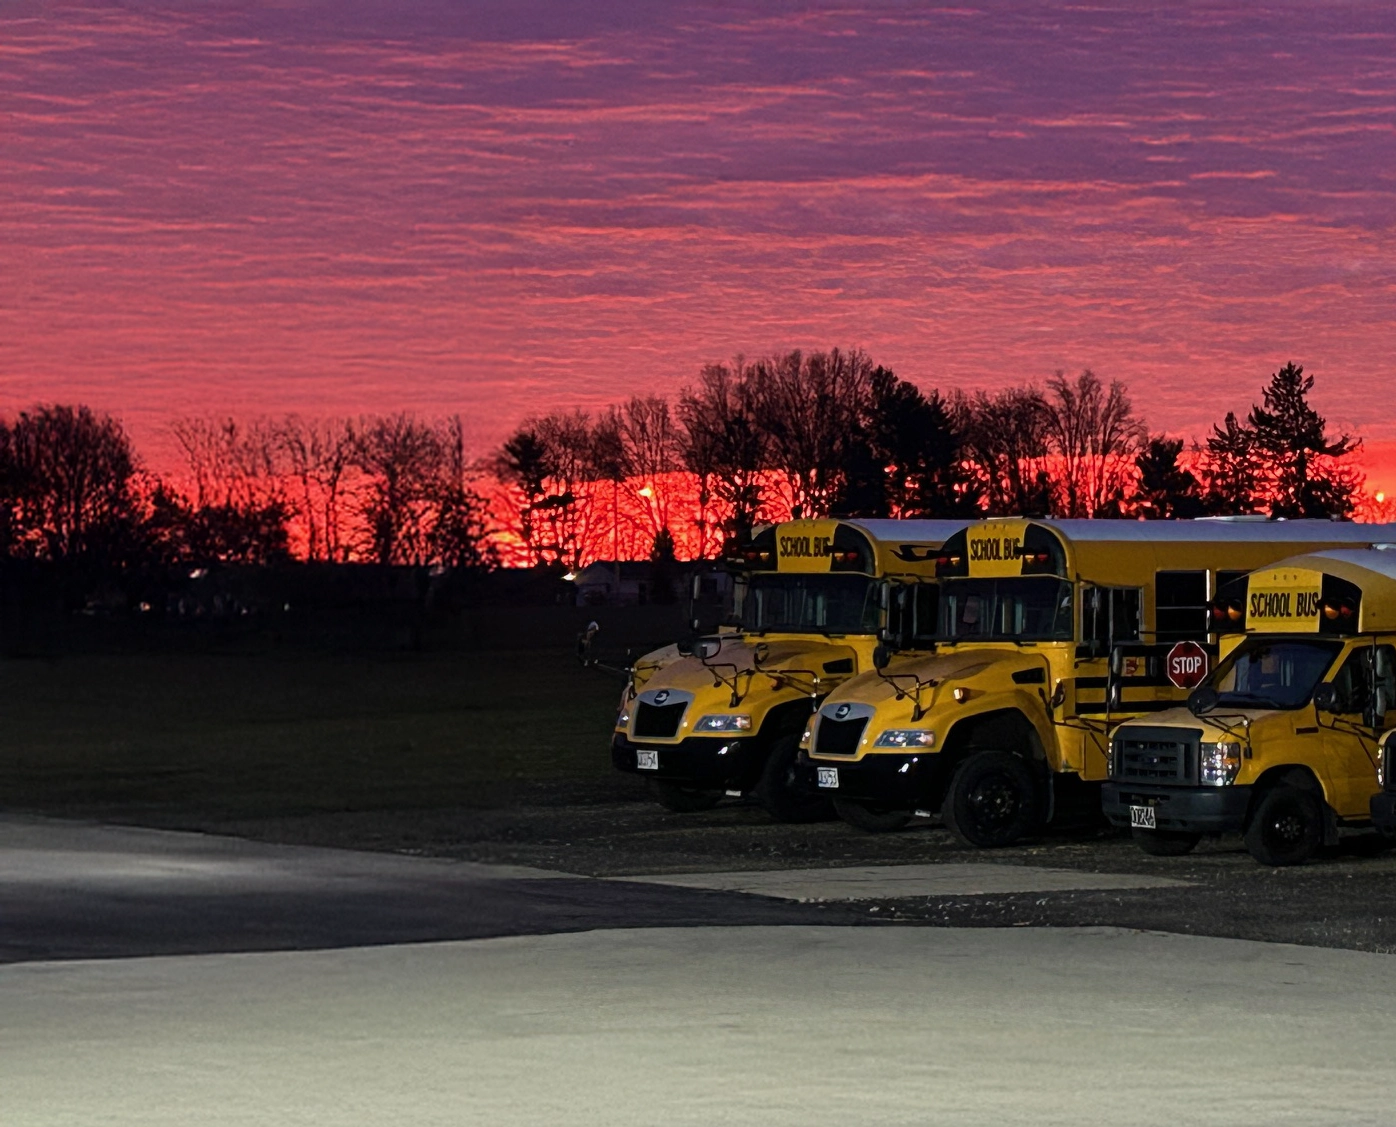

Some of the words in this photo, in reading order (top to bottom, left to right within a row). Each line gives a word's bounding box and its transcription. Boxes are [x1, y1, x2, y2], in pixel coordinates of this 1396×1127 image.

[780, 536, 812, 557] SCHOOL
[813, 536, 831, 557] BUS
[970, 538, 1002, 560] SCHOOL
[1003, 537, 1021, 560] BUS
[1250, 592, 1292, 618] SCHOOL
[1296, 591, 1320, 617] BUS
[1172, 656, 1202, 674] STOP
